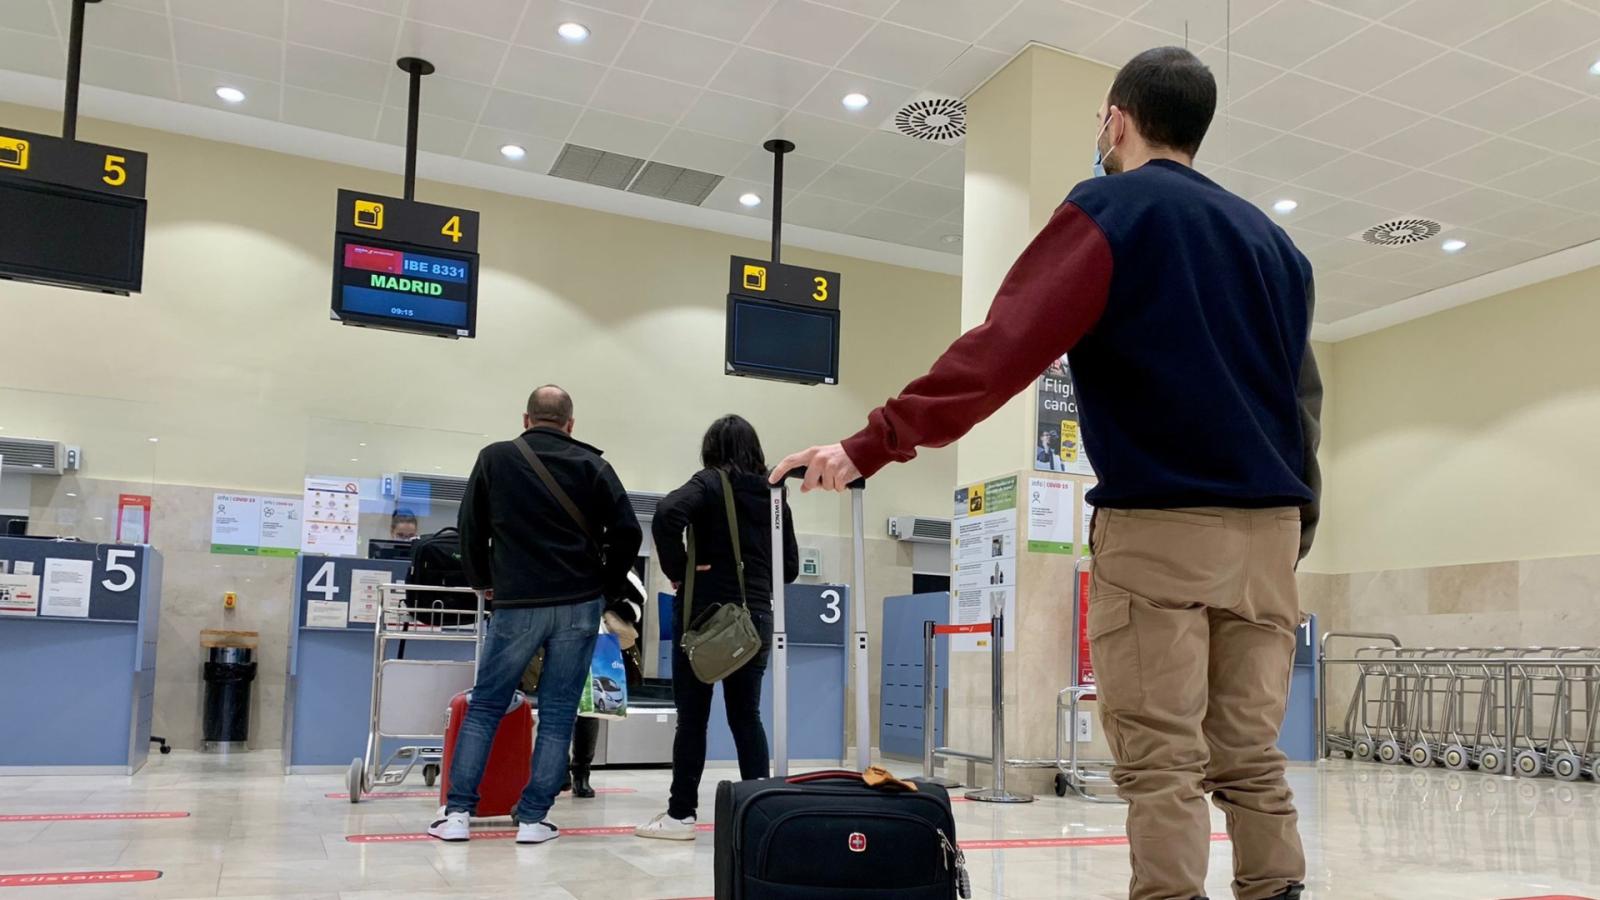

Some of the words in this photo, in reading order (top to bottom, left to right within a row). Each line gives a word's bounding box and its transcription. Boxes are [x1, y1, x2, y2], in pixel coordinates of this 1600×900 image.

[102, 154, 126, 186] 5
[441, 215, 463, 243] 4
[404, 259, 429, 273] IBE
[432, 264, 465, 279] 8331
[370, 274, 443, 296] MADRID
[812, 276, 828, 301] 3
[391, 307, 414, 317] 09:15
[101, 549, 136, 592] 5
[306, 561, 340, 601] 4
[819, 589, 841, 624] 3
[1300, 620, 1311, 646] 1
